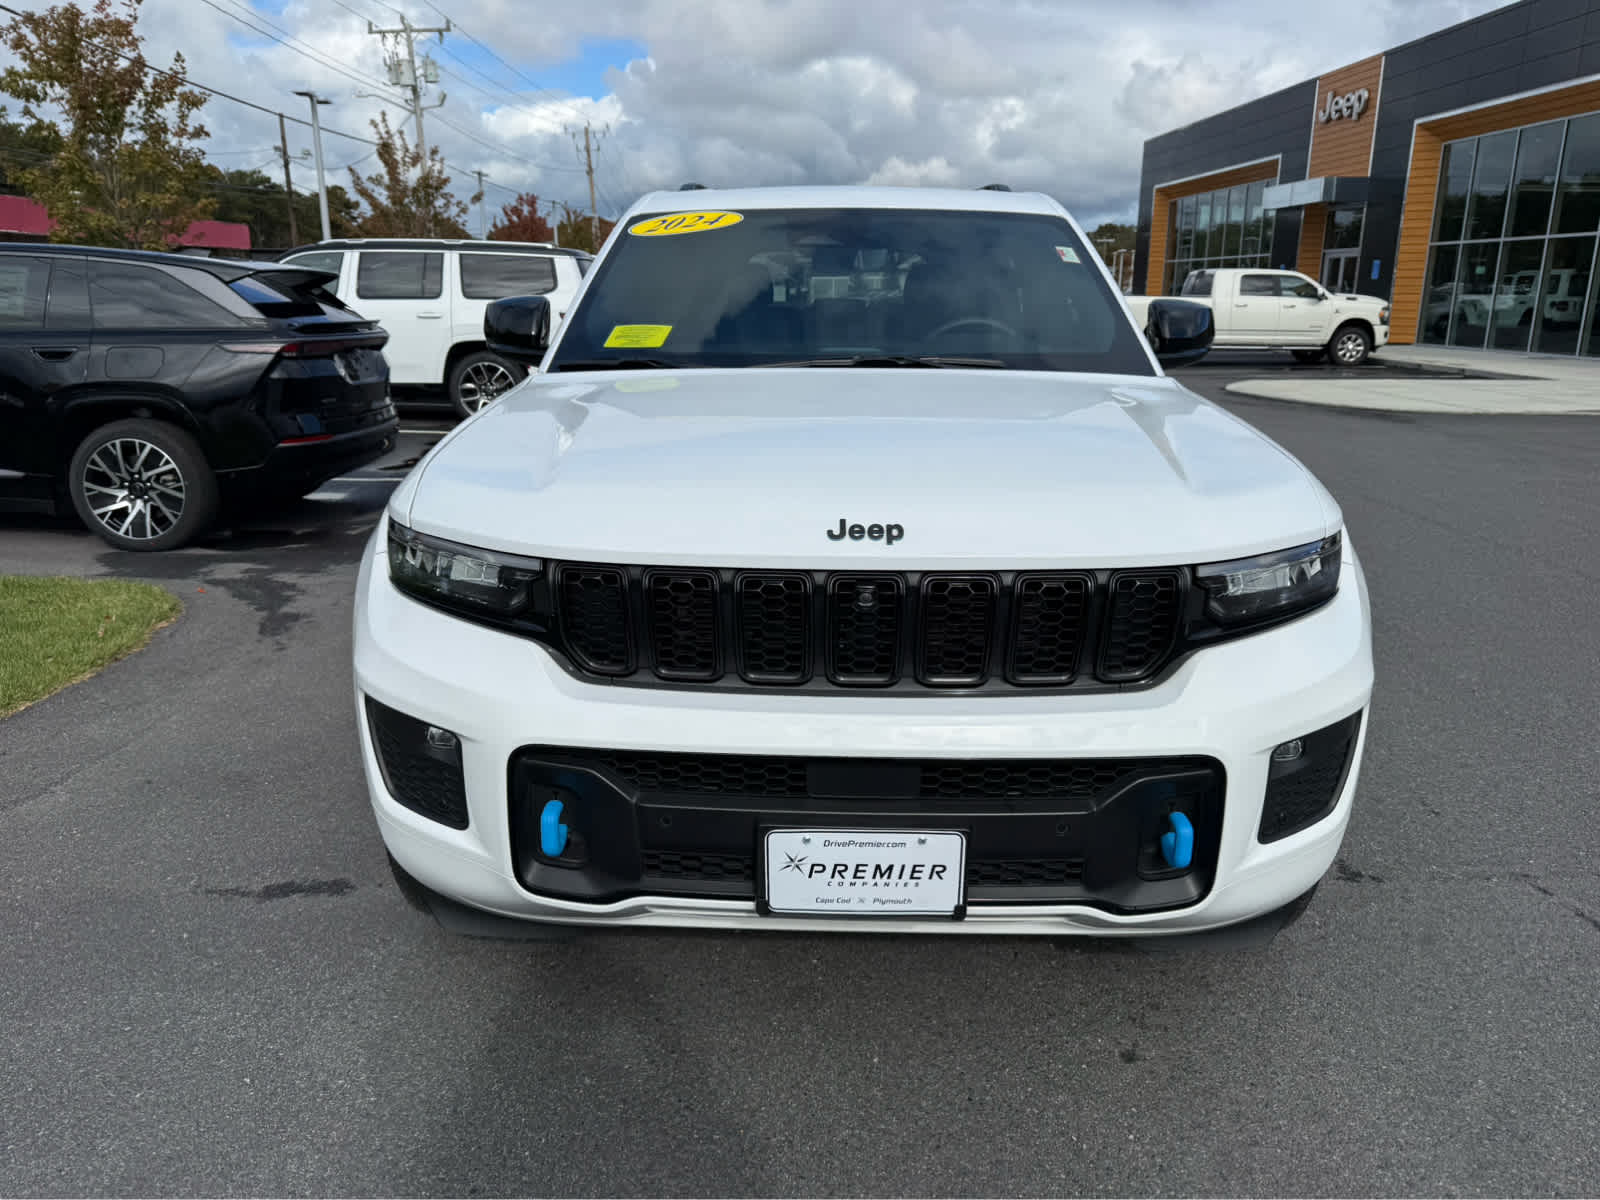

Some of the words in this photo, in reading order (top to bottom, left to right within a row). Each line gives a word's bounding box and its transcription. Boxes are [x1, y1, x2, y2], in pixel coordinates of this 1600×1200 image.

[1318, 88, 1369, 123] Jeep
[644, 214, 729, 233] 2024
[826, 518, 905, 545] Jeep
[823, 839, 907, 848] DrivePremier.com
[807, 863, 947, 880] PREMIER
[815, 896, 835, 905] Cape
[836, 896, 851, 904] Cod
[872, 897, 913, 905] Plymouth
